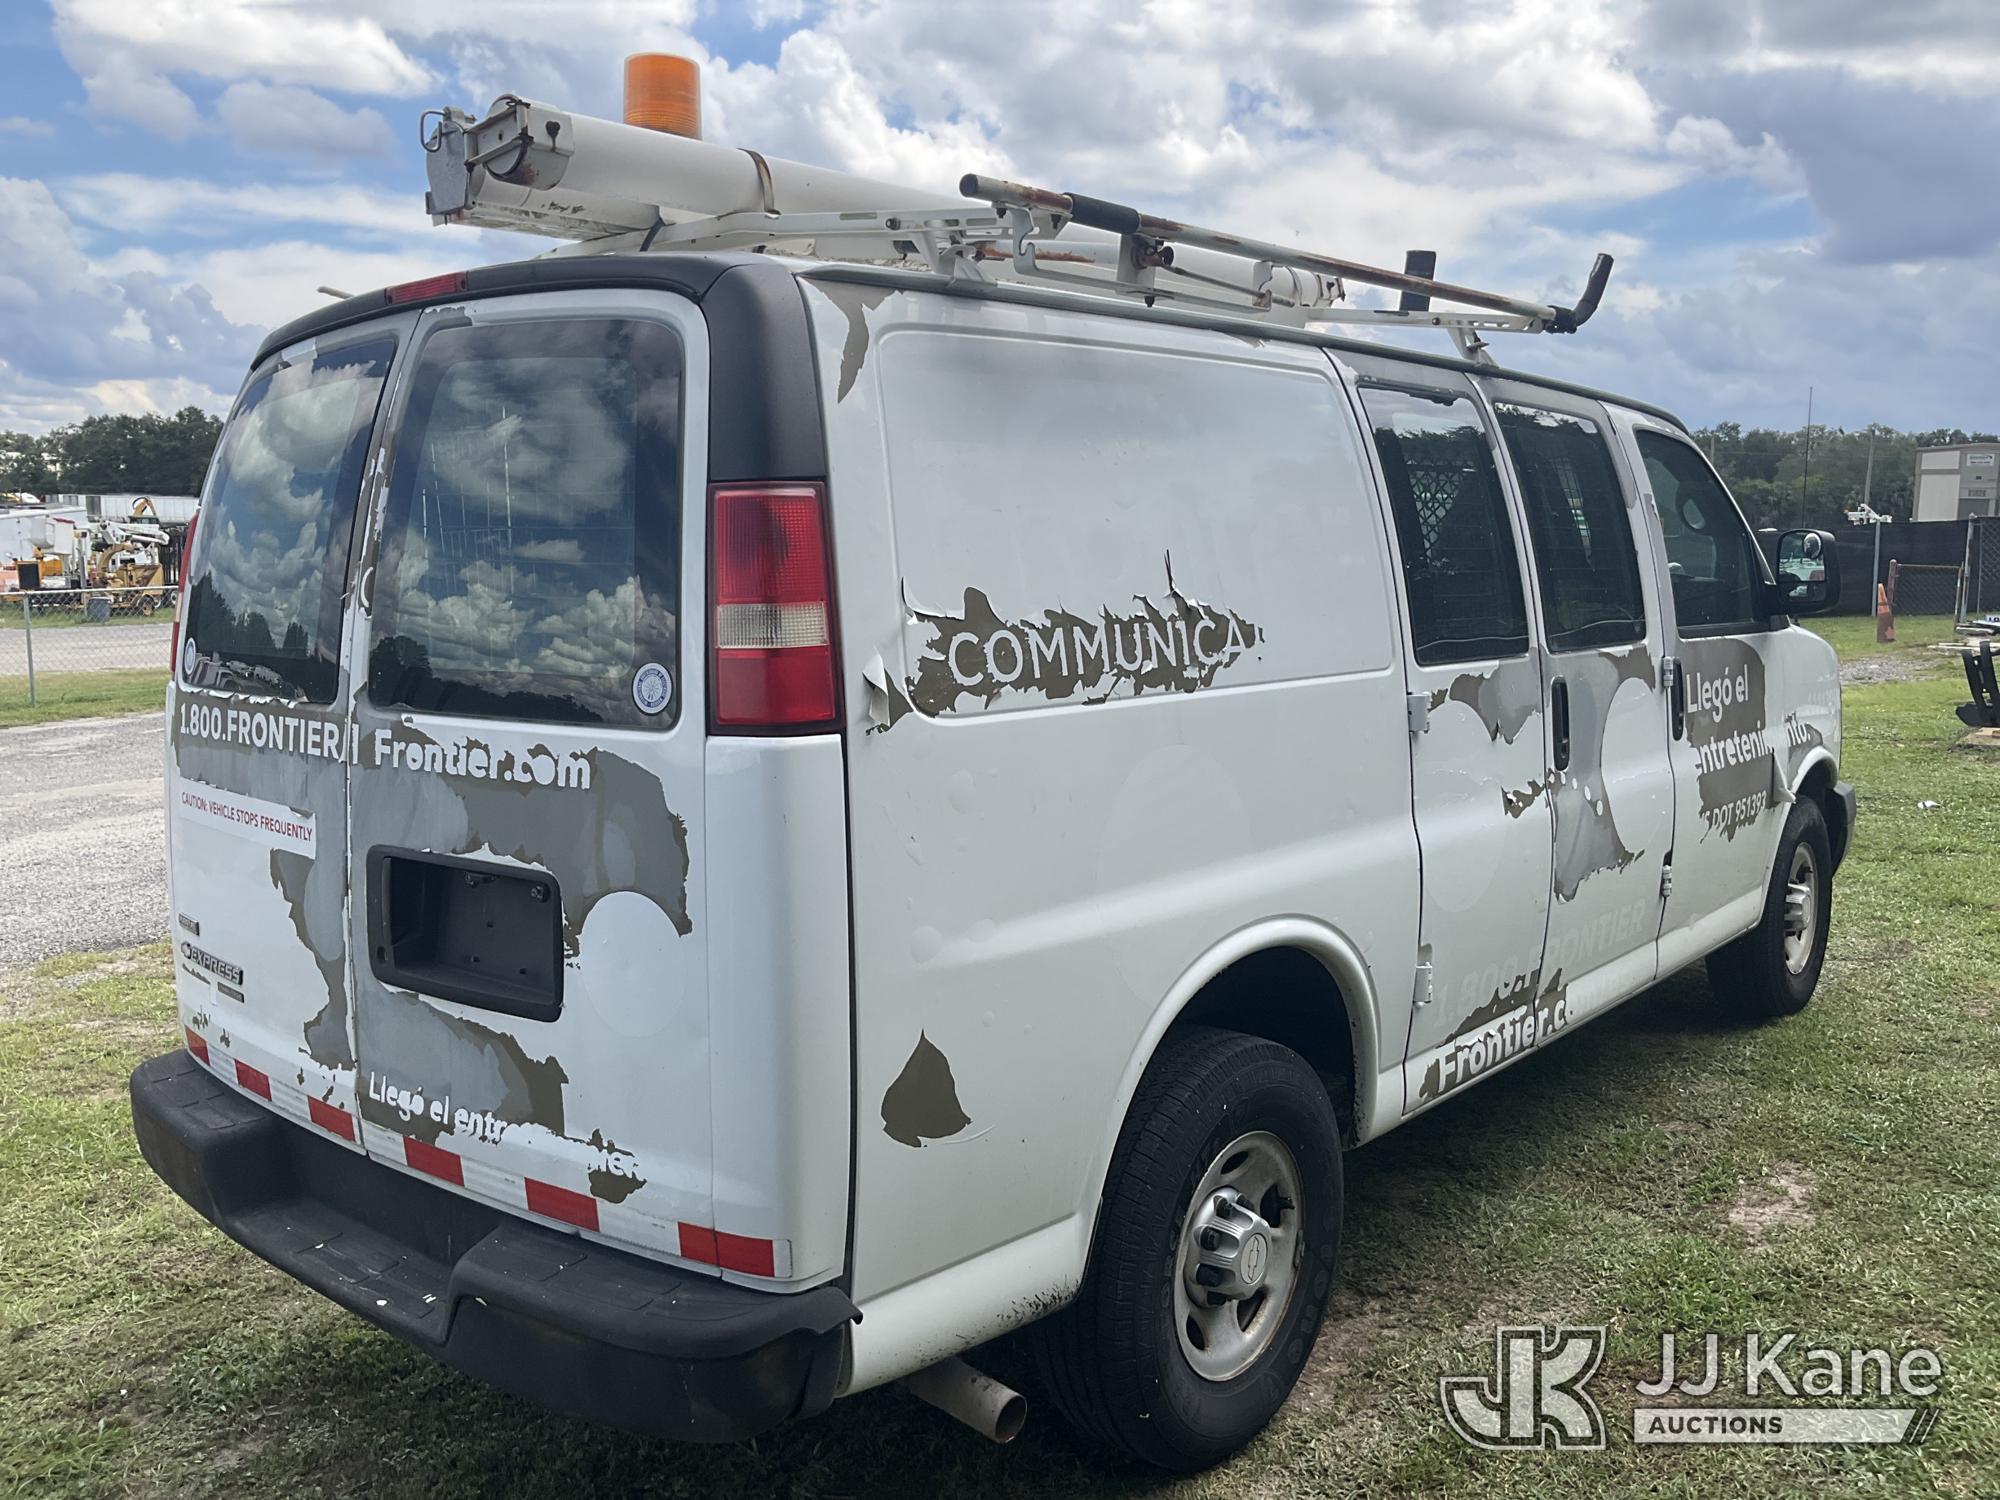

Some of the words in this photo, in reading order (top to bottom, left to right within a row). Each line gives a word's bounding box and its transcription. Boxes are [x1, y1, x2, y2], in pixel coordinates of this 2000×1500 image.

[947, 618, 1264, 687] COMMUNICA
[1686, 666, 1733, 723] Llegó
[1735, 663, 1749, 703] el
[180, 703, 340, 760] 1.800.FRONTIER
[374, 728, 592, 790] Frontier.com
[181, 791, 208, 813] CAUTION:
[208, 800, 235, 820] VEHICLE
[236, 808, 259, 828] STOPS
[260, 815, 313, 842] FREQUENTLY
[1712, 802, 1734, 830] DOT
[1735, 789, 1767, 822] 951393
[191, 945, 242, 986] EXPRESS
[369, 1071, 425, 1122] Llegó
[430, 1095, 450, 1125] el
